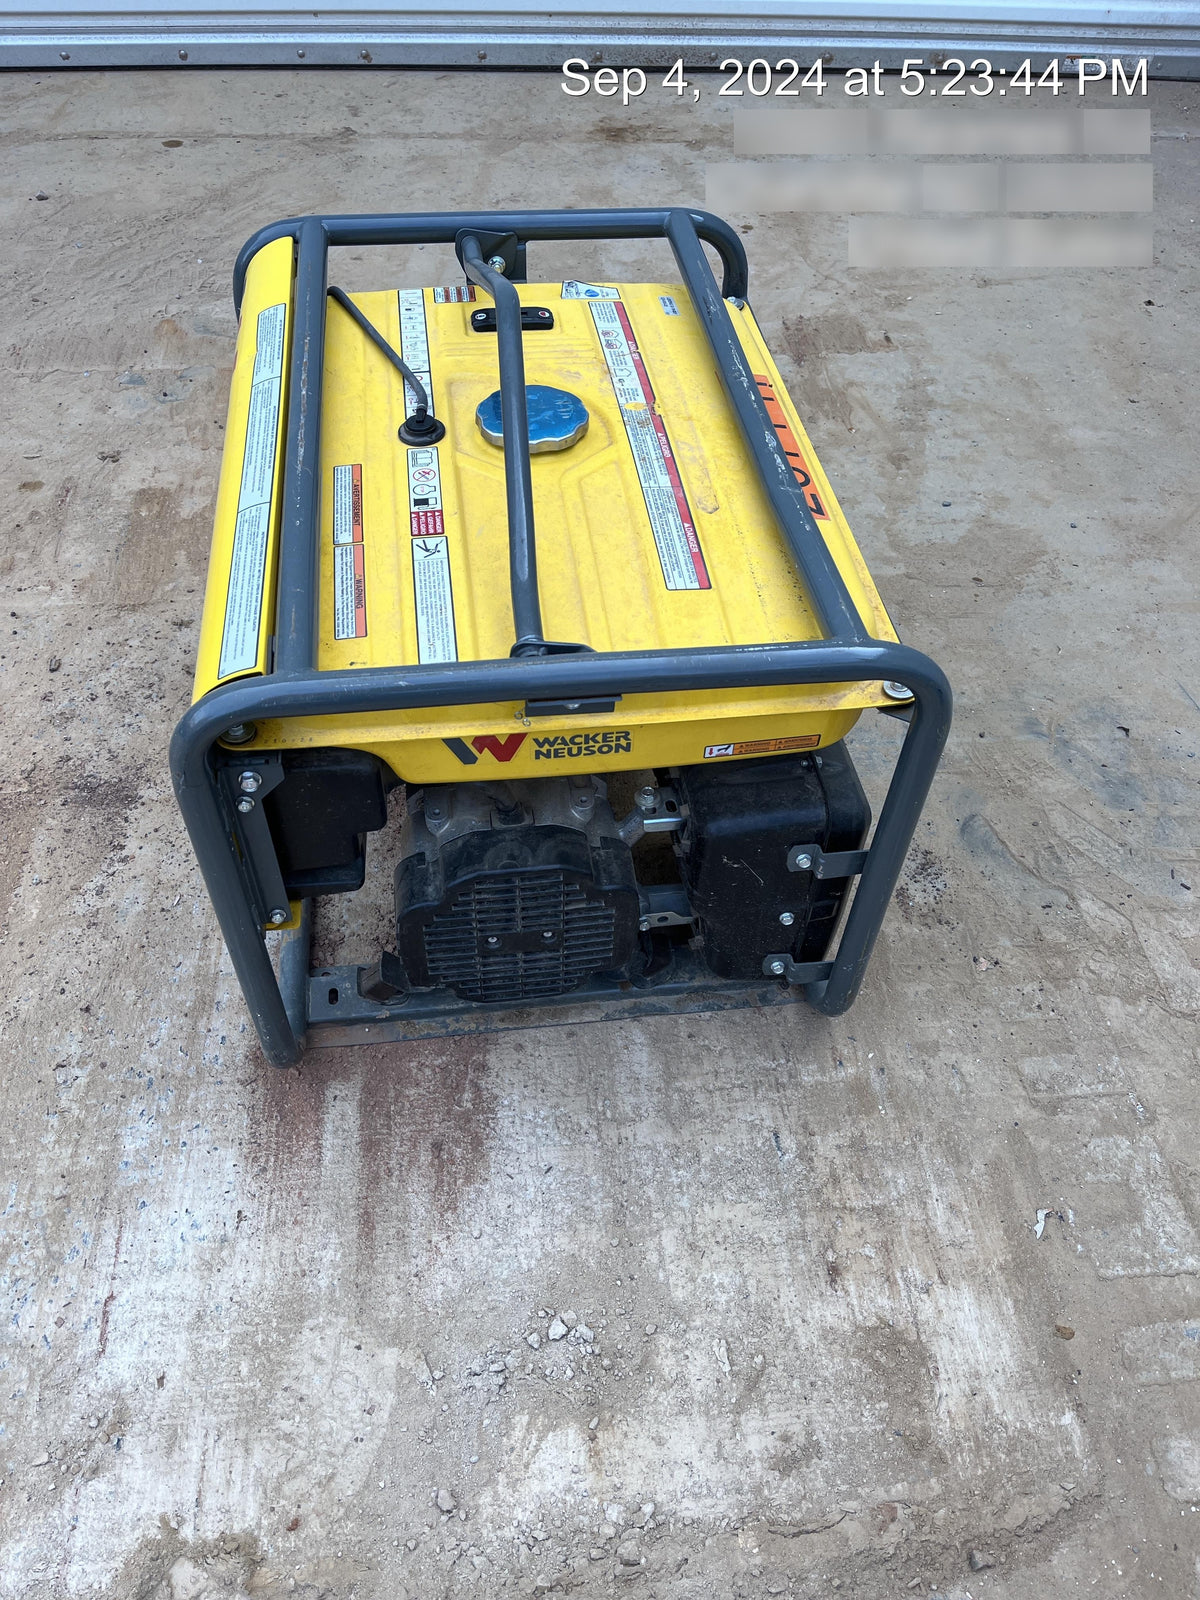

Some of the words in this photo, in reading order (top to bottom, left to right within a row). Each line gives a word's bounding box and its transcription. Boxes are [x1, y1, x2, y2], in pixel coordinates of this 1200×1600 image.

[659, 436, 672, 458] PELIGRO
[353, 483, 362, 527] AVERTISSEMENT
[685, 526, 699, 553] DANGER
[355, 579, 364, 609] WARNING
[532, 730, 632, 748] WACKER
[534, 741, 632, 760] NEUSON
